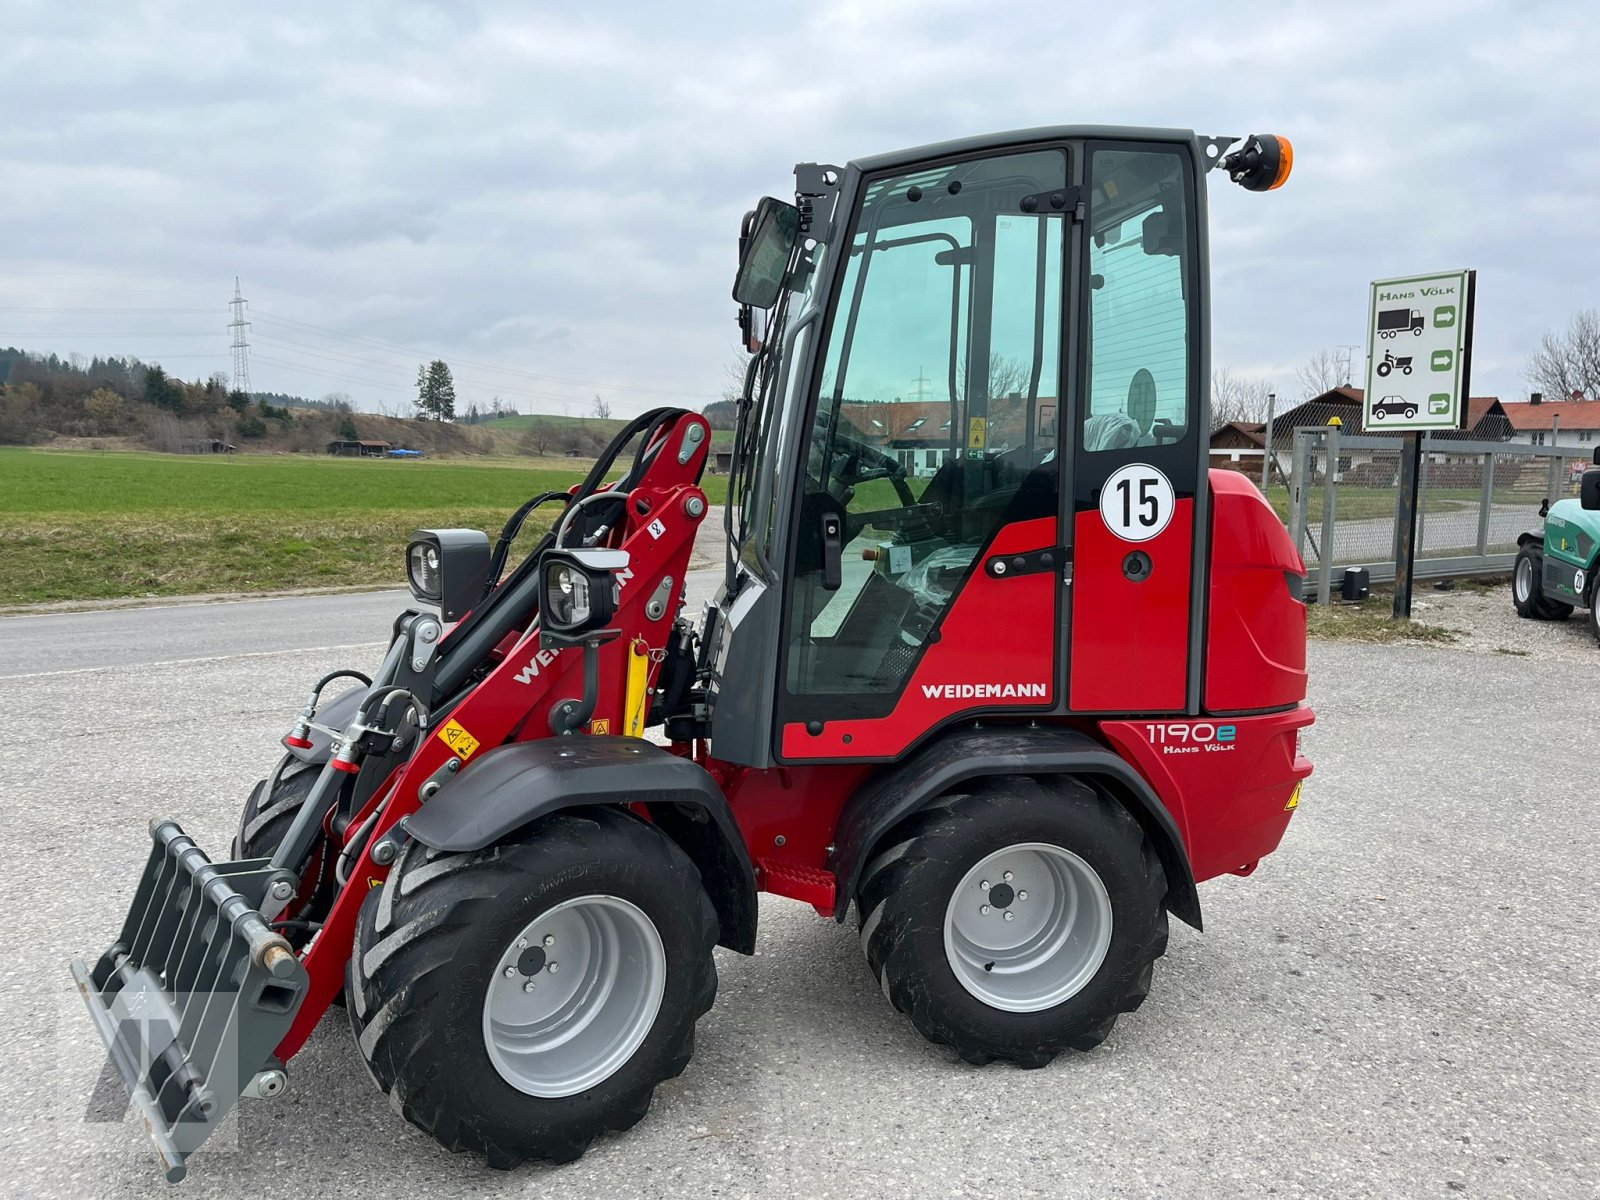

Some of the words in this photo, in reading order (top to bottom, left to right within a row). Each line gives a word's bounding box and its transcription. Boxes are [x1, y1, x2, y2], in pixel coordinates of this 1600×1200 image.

[1380, 292, 1415, 301] HANS
[1116, 478, 1158, 528] 15
[1576, 573, 1583, 590] 20
[921, 683, 1046, 699] WEIDEMANN
[1146, 723, 1236, 744] 1190e
[1163, 746, 1199, 754] HANS
